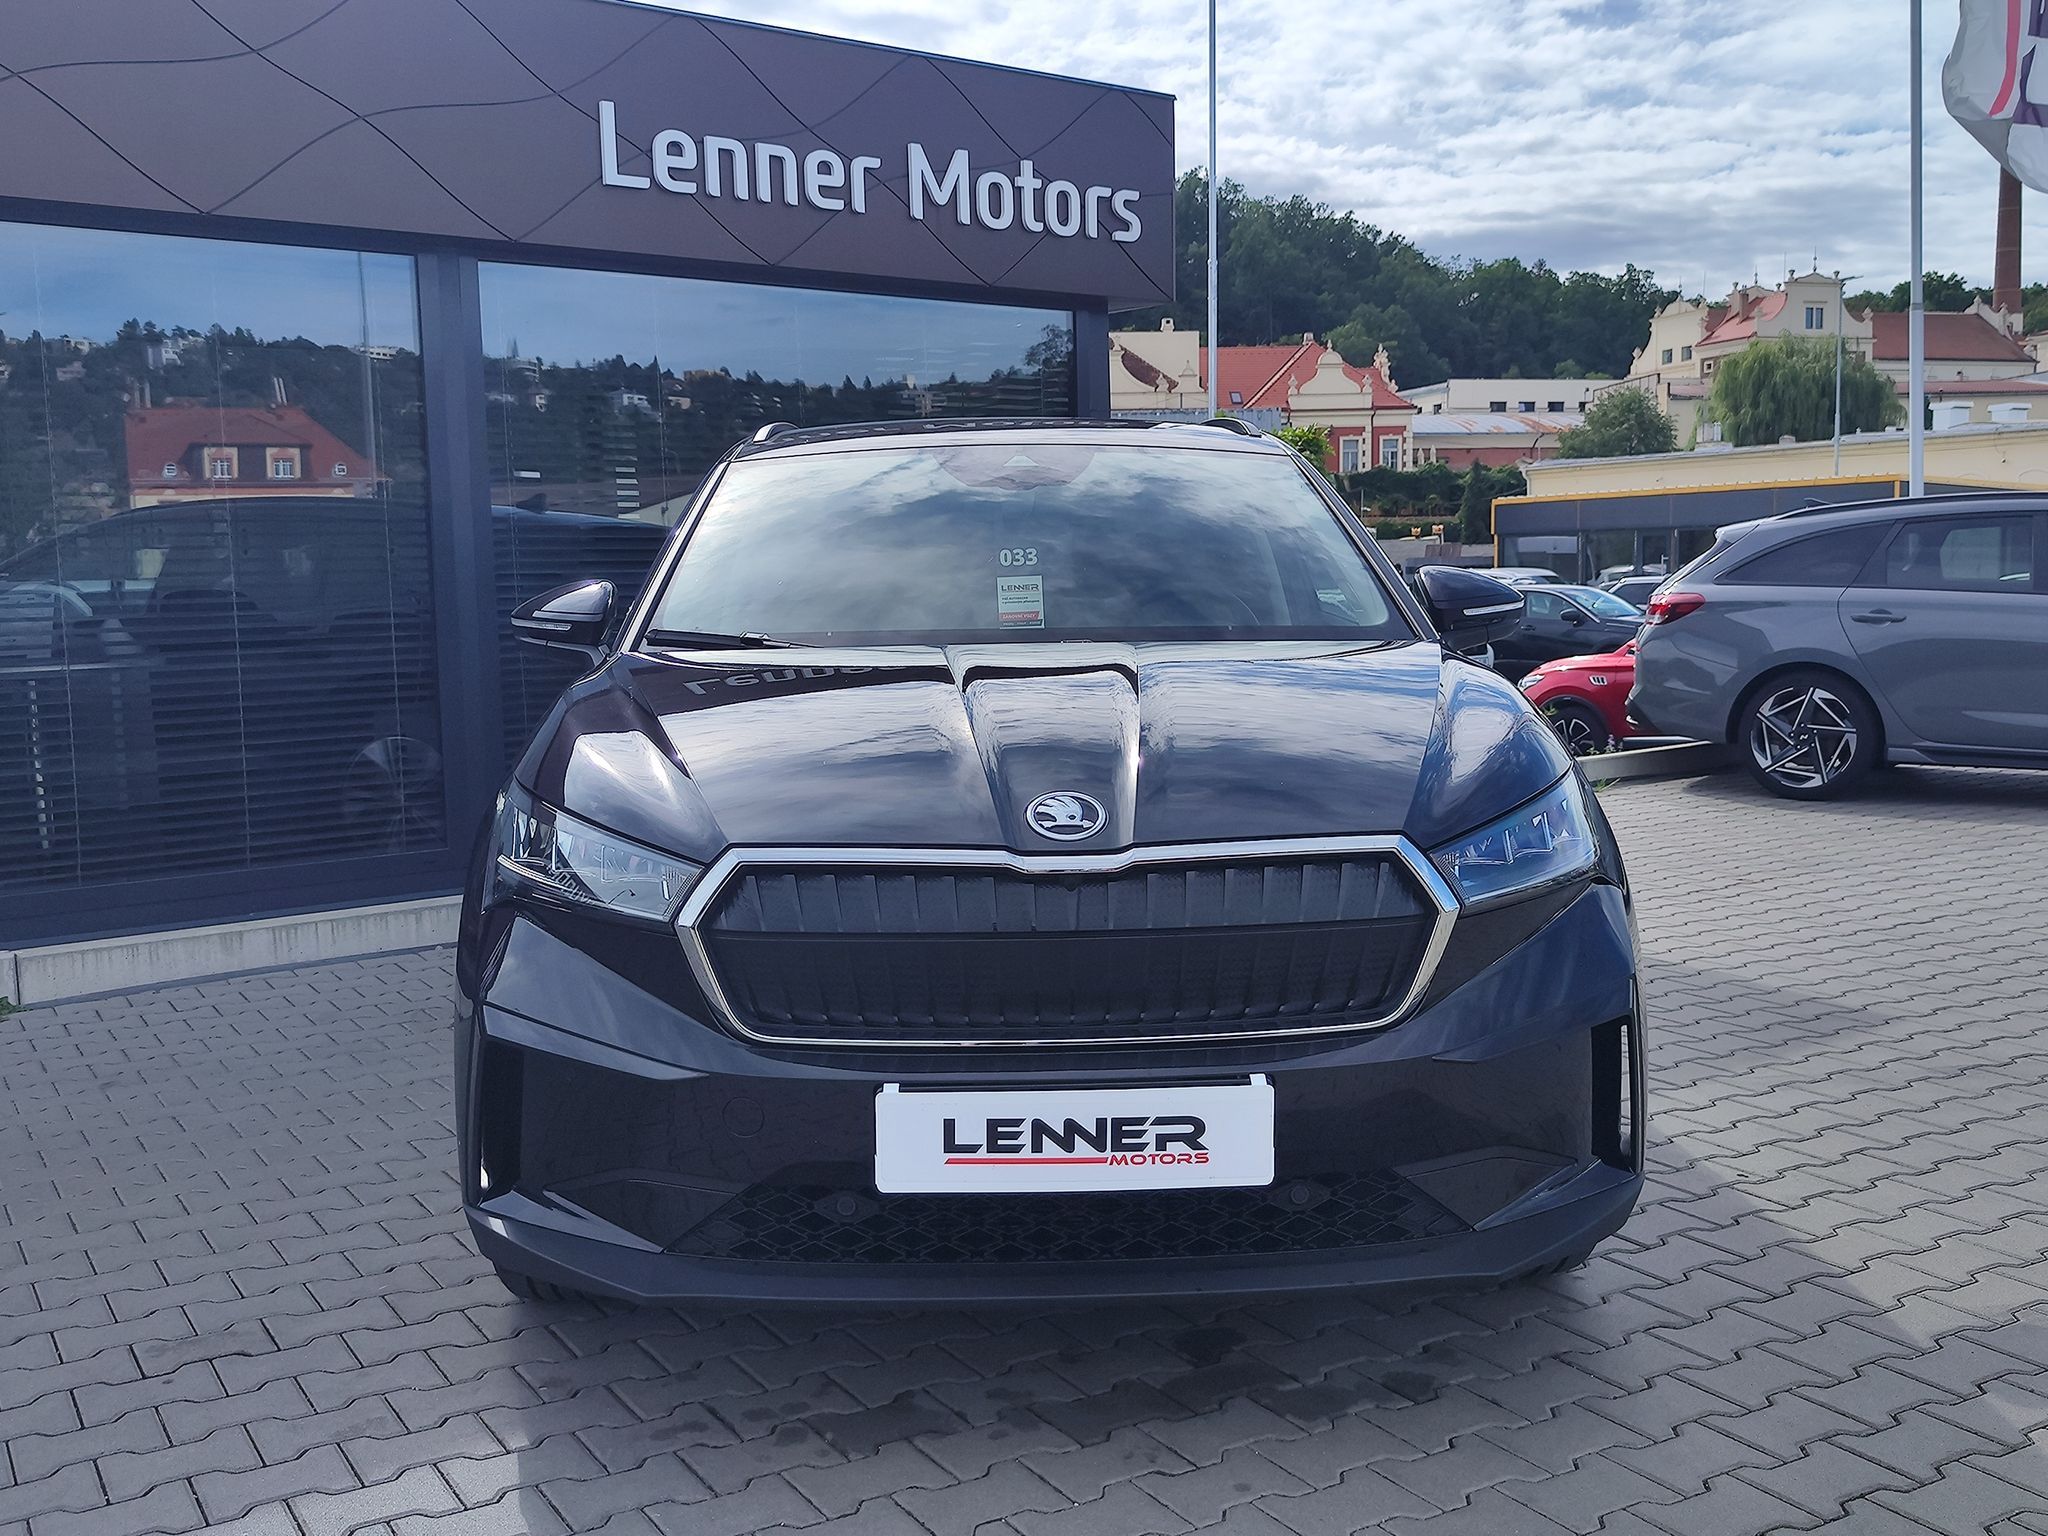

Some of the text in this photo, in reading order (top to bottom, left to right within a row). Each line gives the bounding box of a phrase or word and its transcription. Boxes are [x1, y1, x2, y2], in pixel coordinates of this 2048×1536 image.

[598, 100, 1142, 243] Lenner Motors
[1000, 547, 1038, 566] 033
[943, 1115, 1210, 1153] LENNER
[1109, 1152, 1209, 1166] MOTORS
